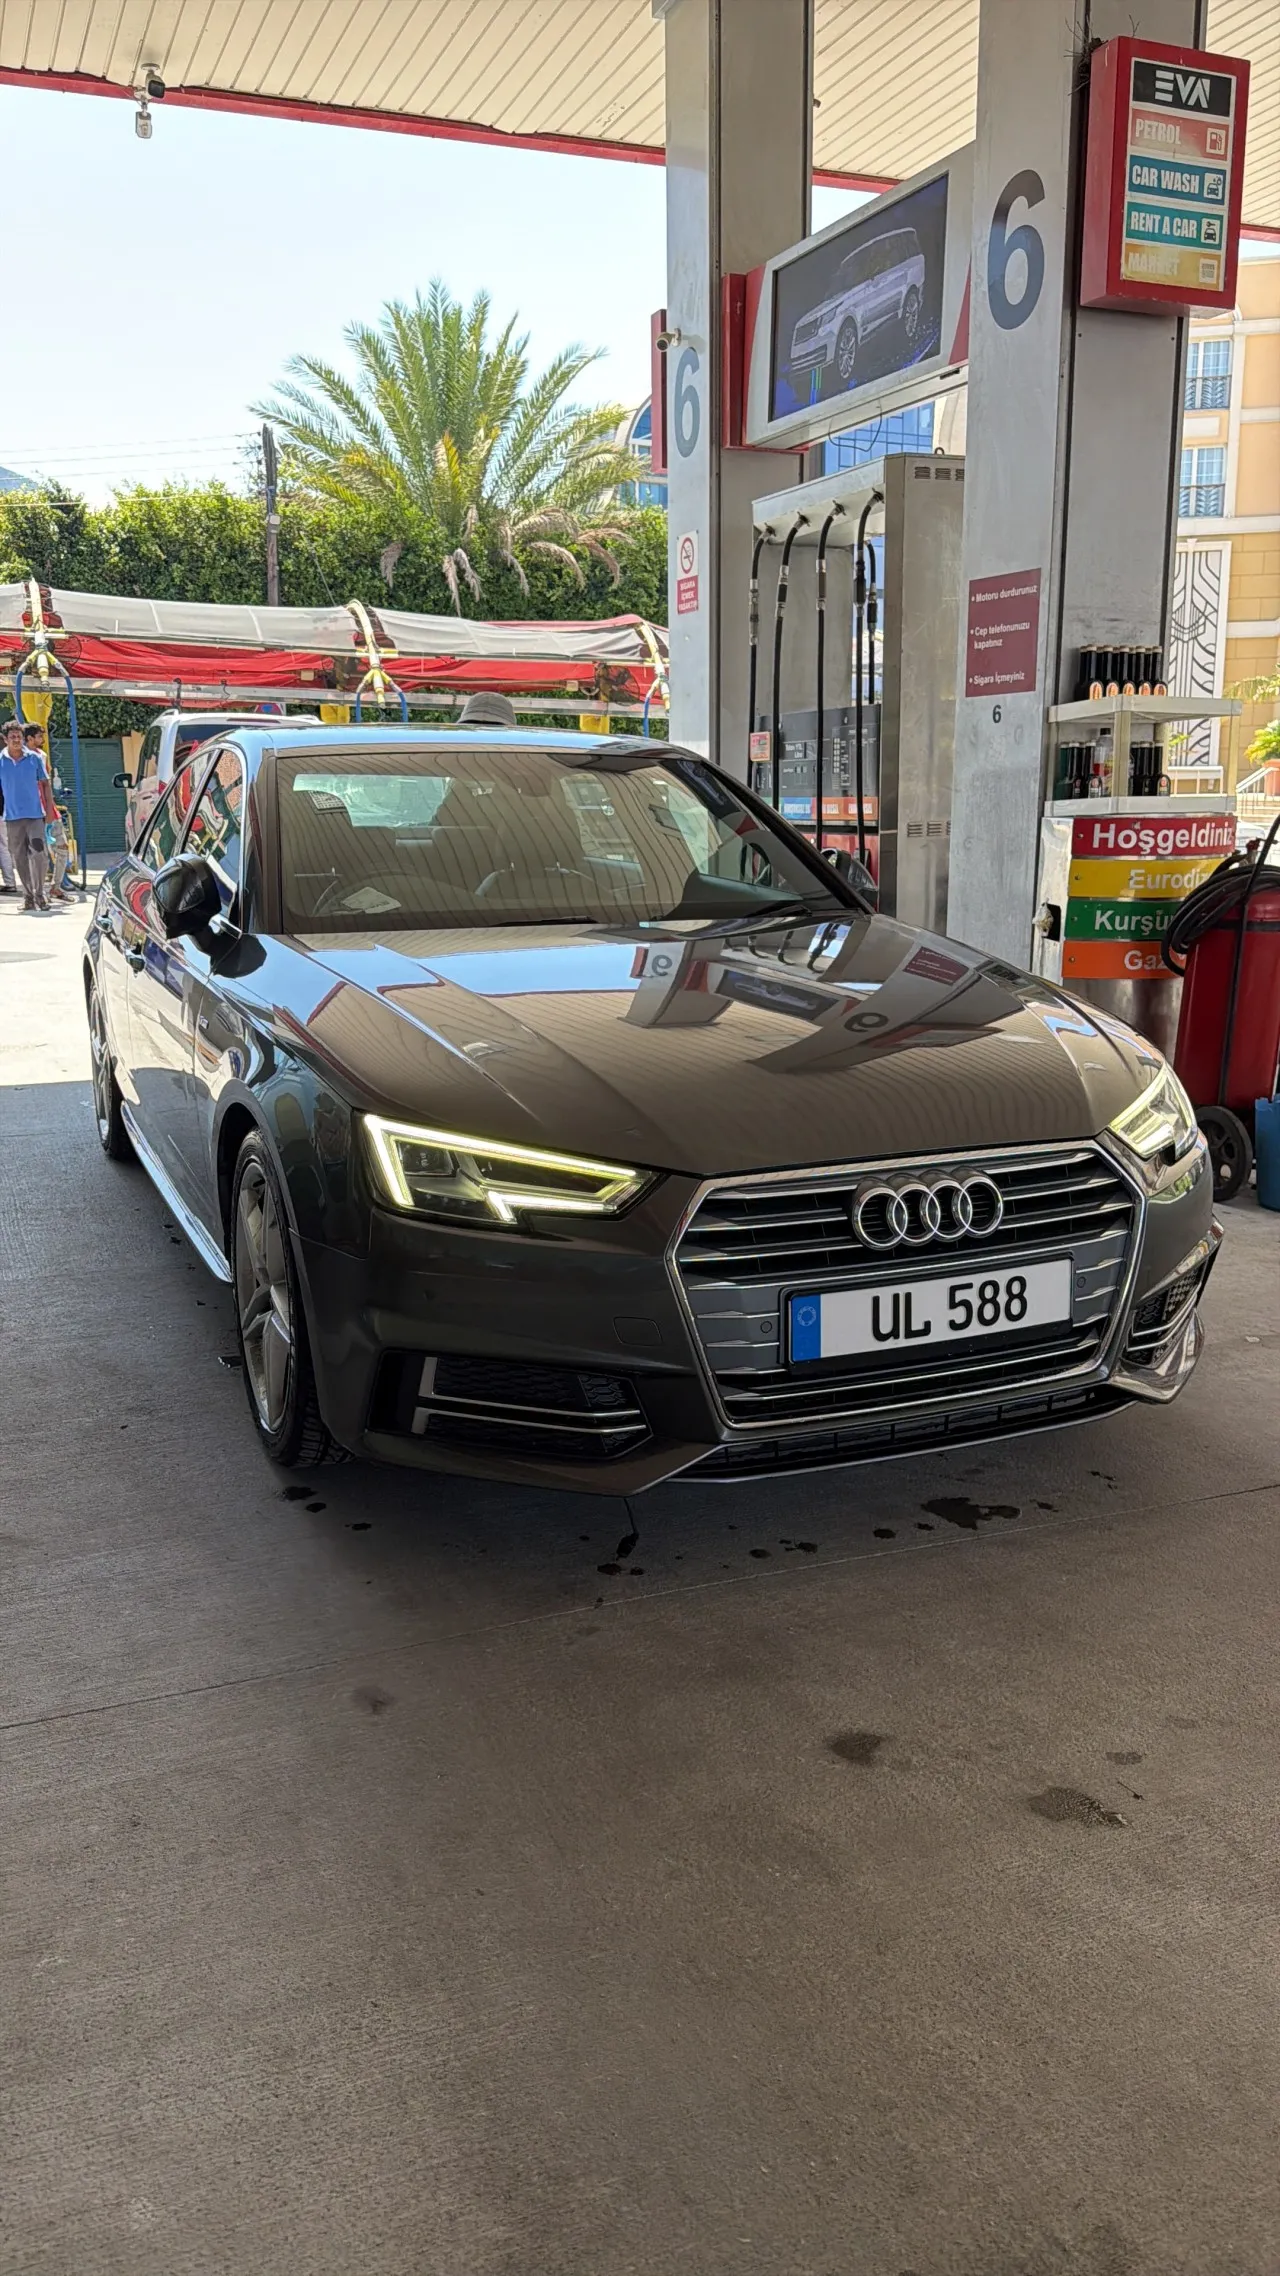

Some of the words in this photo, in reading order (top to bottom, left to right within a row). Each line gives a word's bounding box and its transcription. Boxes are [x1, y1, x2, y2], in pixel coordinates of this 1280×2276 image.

[1154, 69, 1211, 109] EVA
[1135, 118, 1182, 145] PETROL
[1132, 164, 1158, 187] CAR
[1160, 169, 1200, 194] WASH
[1130, 211, 1160, 233] RENT
[1163, 215, 1171, 235] A
[1172, 217, 1197, 239] CAR
[987, 169, 1046, 331] 6
[674, 347, 700, 458] 6
[975, 590, 999, 602] Motoru
[1000, 585, 1038, 599] durdurunuz
[975, 626, 988, 637] Cep
[988, 621, 1030, 635] telefonunuzu
[974, 638, 1003, 651] kapatınız
[973, 675, 994, 687] Sigara
[992, 704, 1002, 724] 6
[1092, 821, 1234, 855] Hoşgeldiniz
[1094, 909, 1174, 936] Kurşu
[871, 1291, 932, 1342] UL
[948, 1275, 1028, 1331] 588
